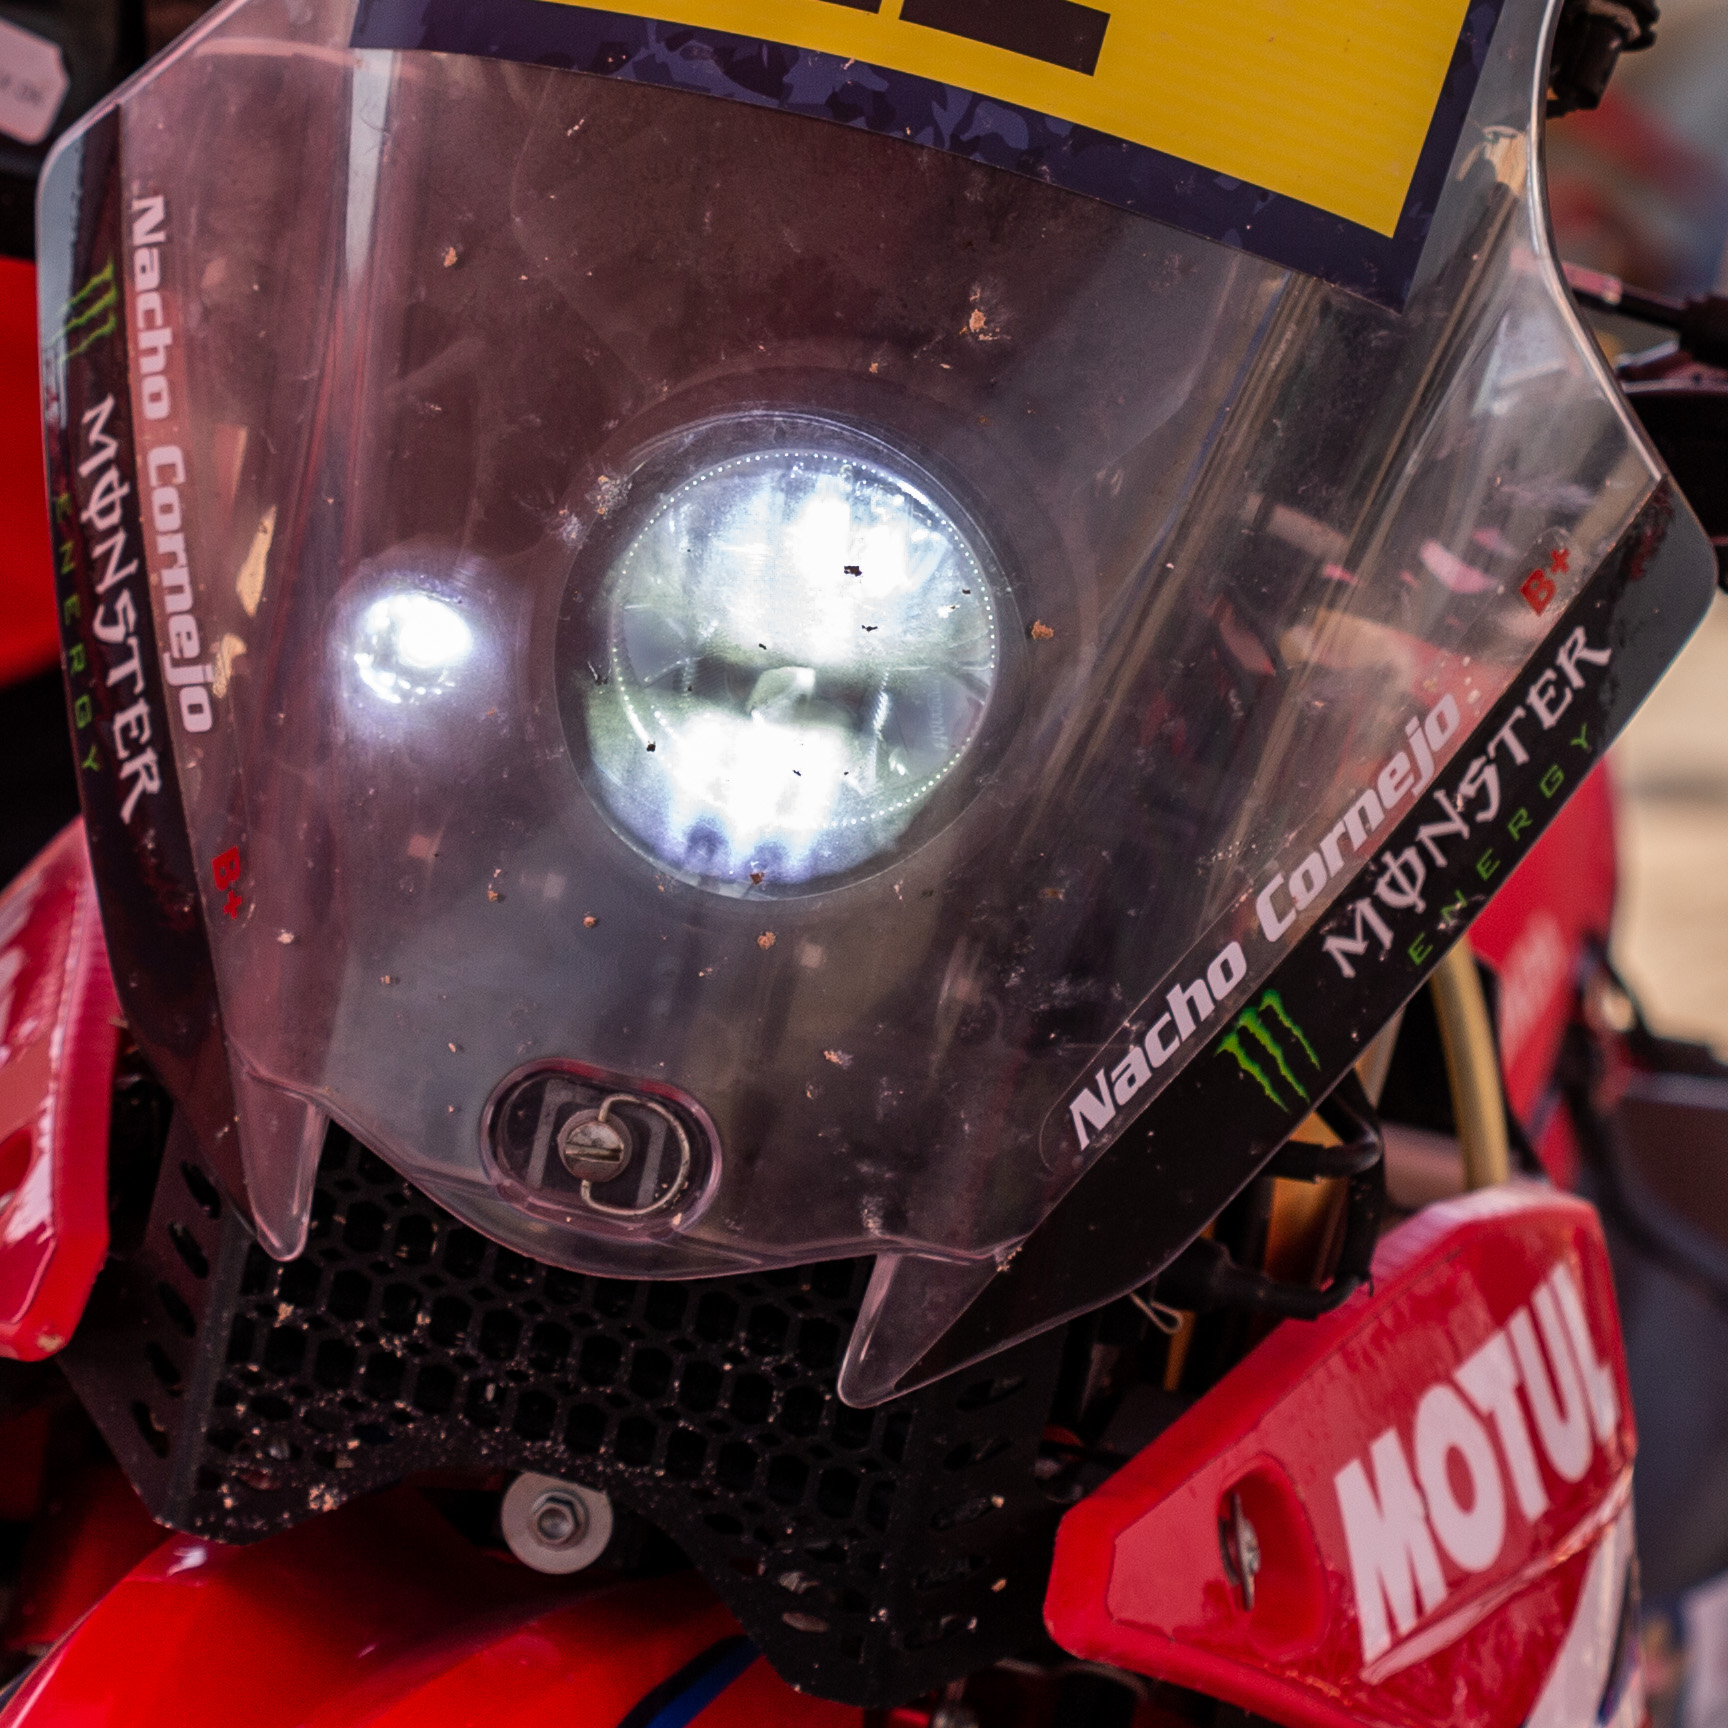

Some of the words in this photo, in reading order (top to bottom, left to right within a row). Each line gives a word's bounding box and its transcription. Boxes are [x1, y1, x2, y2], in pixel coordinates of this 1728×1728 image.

[131, 194, 171, 419] Nacho
[53, 490, 102, 772] ENERGY
[77, 393, 162, 825] MONSTER
[146, 445, 214, 734] Cornejo
[1520, 548, 1570, 615] B+
[211, 845, 243, 919] B+
[1069, 940, 1248, 1152] Nacho
[1255, 693, 1462, 943] Cornejo
[1321, 625, 1612, 978] MONSTER
[1408, 723, 1592, 966] ENERGY
[1333, 1262, 1617, 1663] MOTUL
